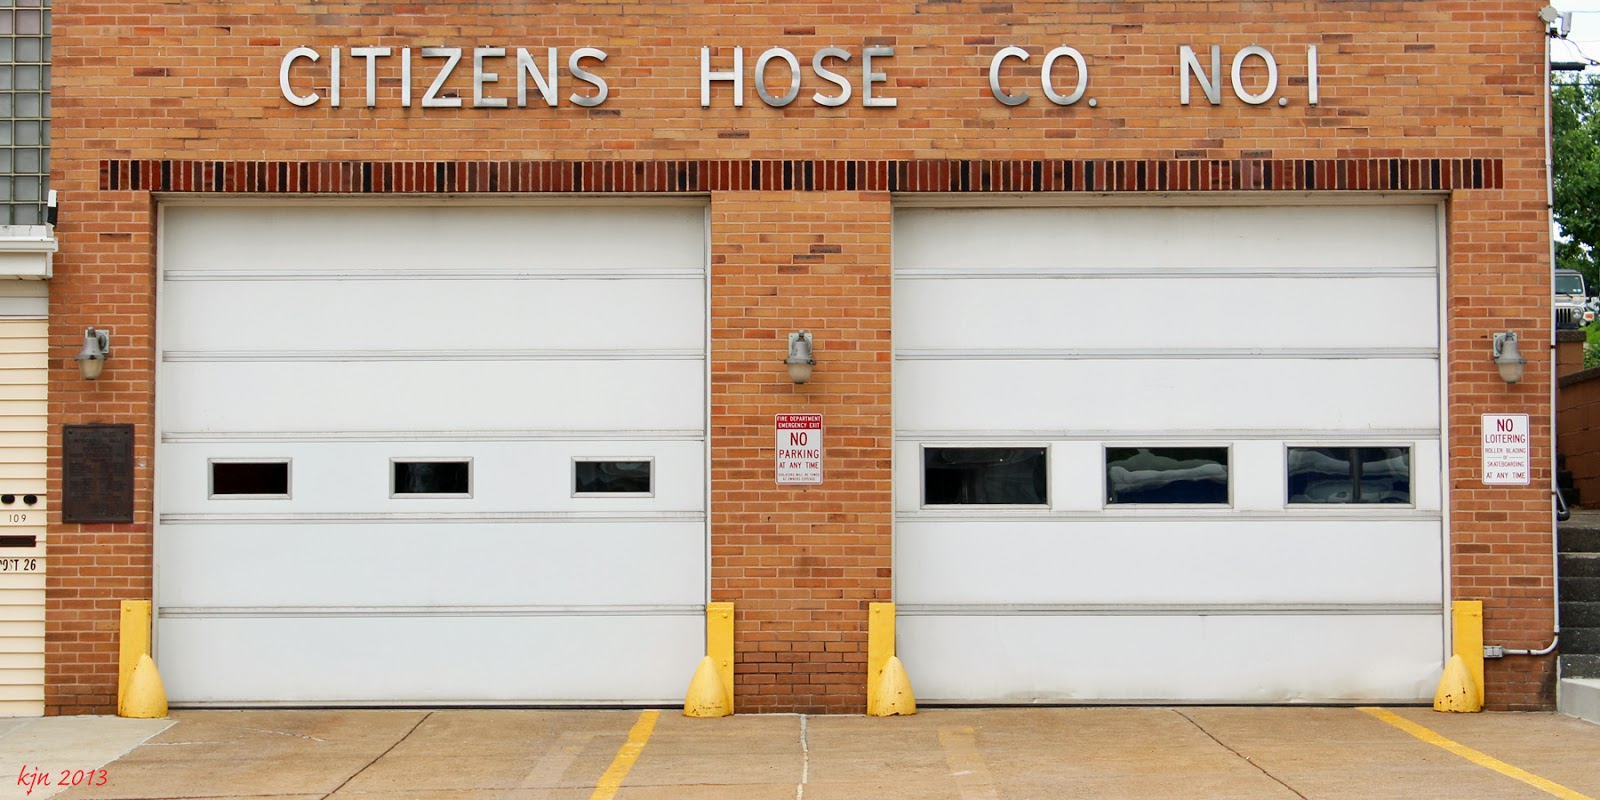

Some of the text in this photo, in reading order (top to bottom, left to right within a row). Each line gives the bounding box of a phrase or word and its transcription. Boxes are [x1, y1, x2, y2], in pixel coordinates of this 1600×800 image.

[279, 46, 609, 108] CITIZENS
[700, 46, 898, 108] HOSE
[988, 45, 1097, 107] CO.
[1496, 418, 1514, 432] NO
[790, 432, 808, 446] NO
[1485, 434, 1526, 444] LOITERING
[779, 450, 819, 458] PARKING
[9, 514, 26, 522] 109
[24, 558, 36, 570] 26
